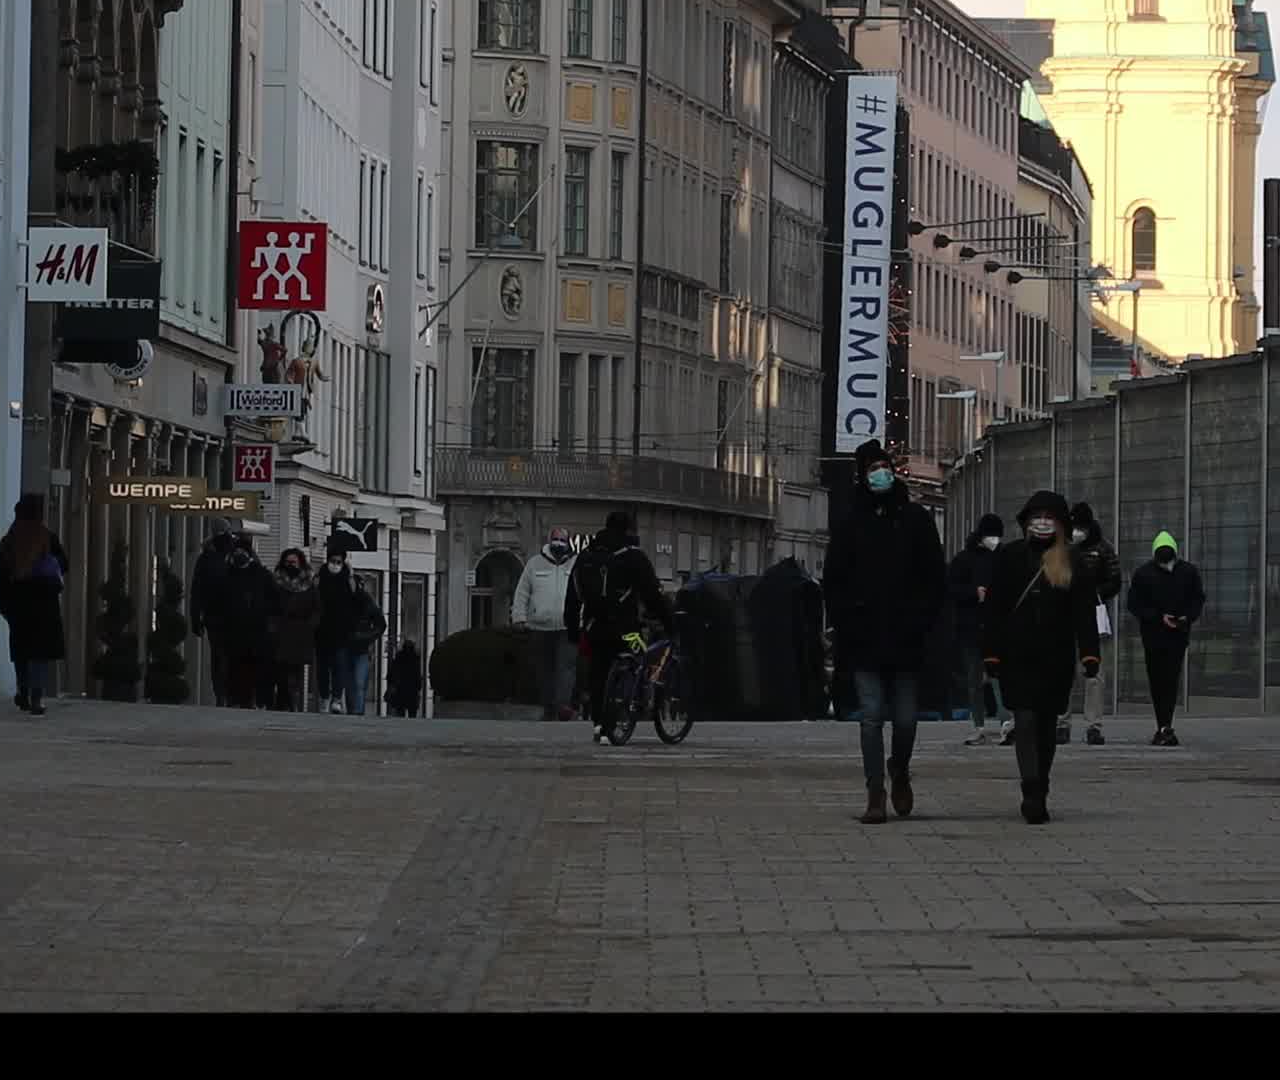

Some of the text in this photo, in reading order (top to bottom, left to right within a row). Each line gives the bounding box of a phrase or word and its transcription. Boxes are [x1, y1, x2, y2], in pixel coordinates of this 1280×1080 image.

[36, 243, 99, 286] H&M
[844, 93, 888, 435] #MUGLERMUC
[242, 394, 283, 406] Wolford
[109, 483, 193, 498] WEMPE
[170, 497, 246, 510] MPE
